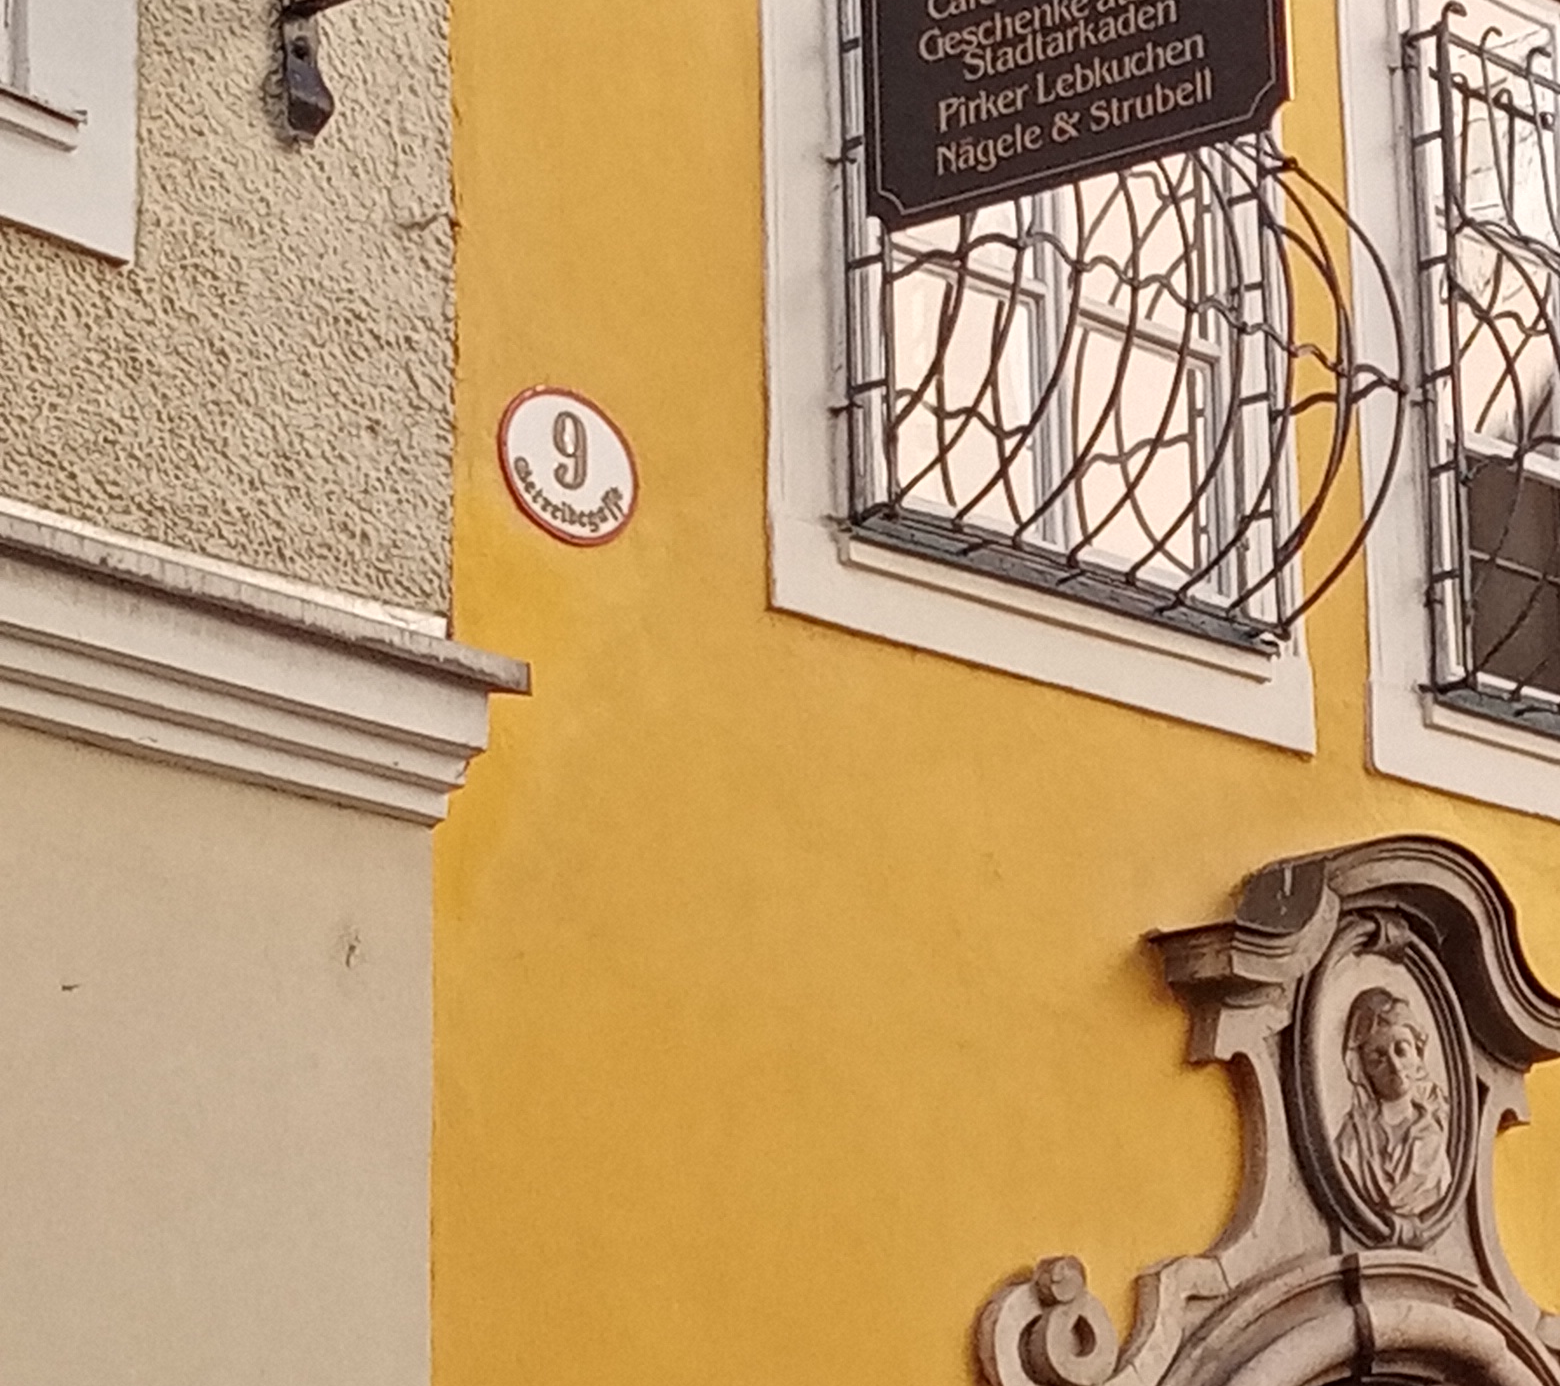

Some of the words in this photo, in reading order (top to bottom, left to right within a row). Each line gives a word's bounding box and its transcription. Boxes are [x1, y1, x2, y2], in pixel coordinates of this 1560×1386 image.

[938, 83, 1029, 134] Pirker
[1036, 33, 1205, 105] Lebkuchen
[1051, 111, 1081, 144] &
[1089, 67, 1214, 132] Strubell
[553, 410, 588, 491] 9
